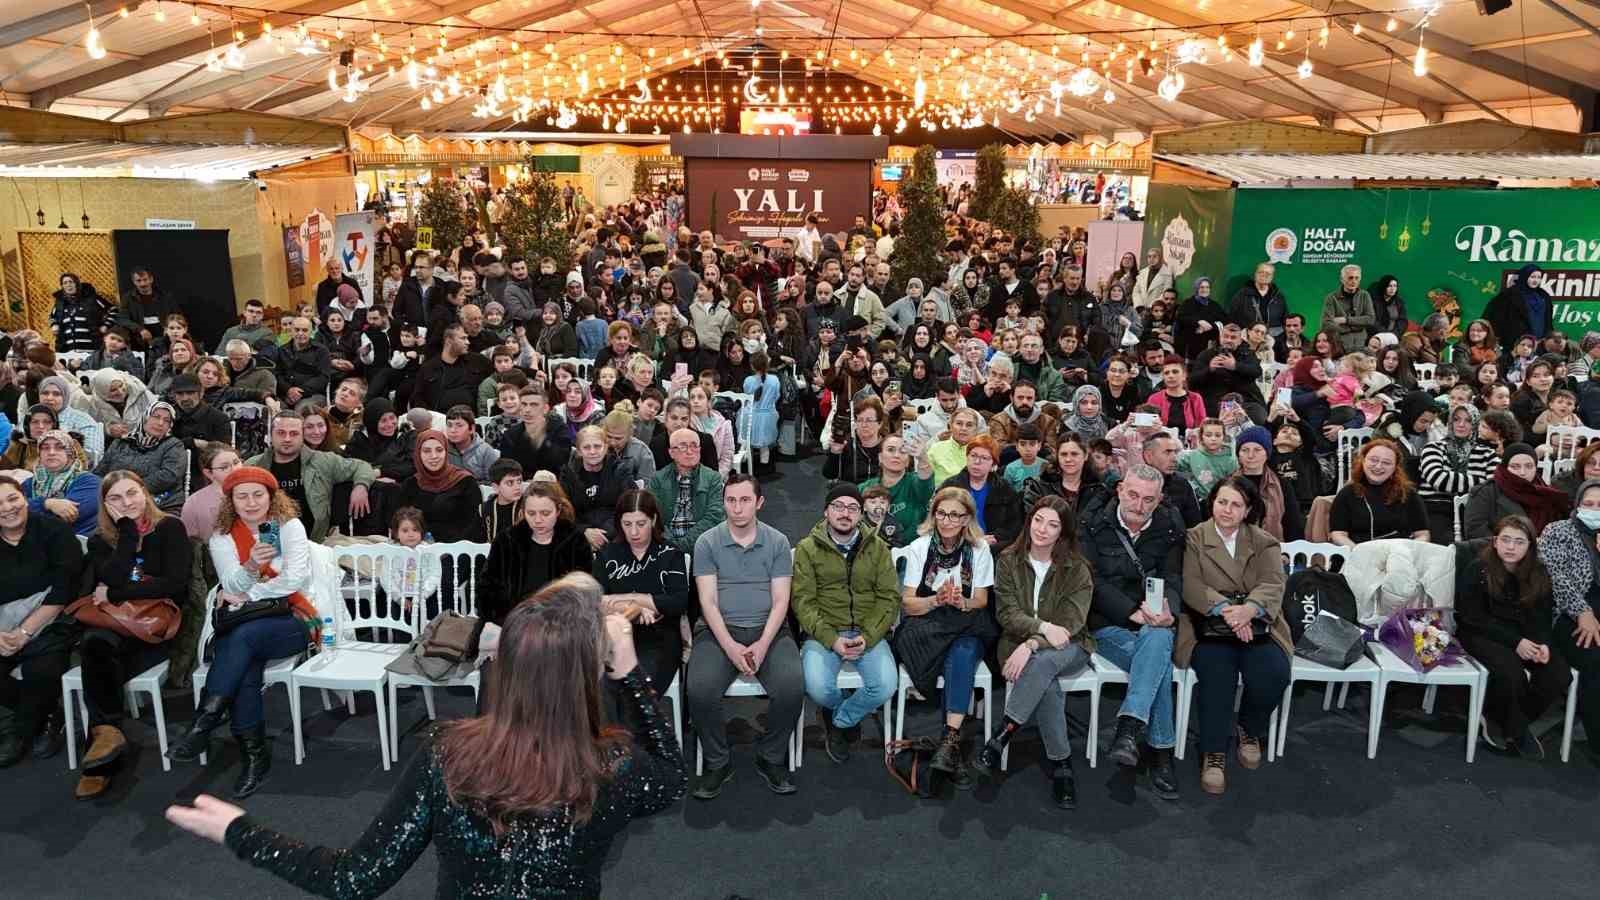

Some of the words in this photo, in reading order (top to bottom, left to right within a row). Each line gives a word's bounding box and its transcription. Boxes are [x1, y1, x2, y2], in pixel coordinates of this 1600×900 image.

[733, 188, 824, 213] YALI
[418, 231, 431, 245] 40
[1303, 239, 1355, 252] DOĞAN
